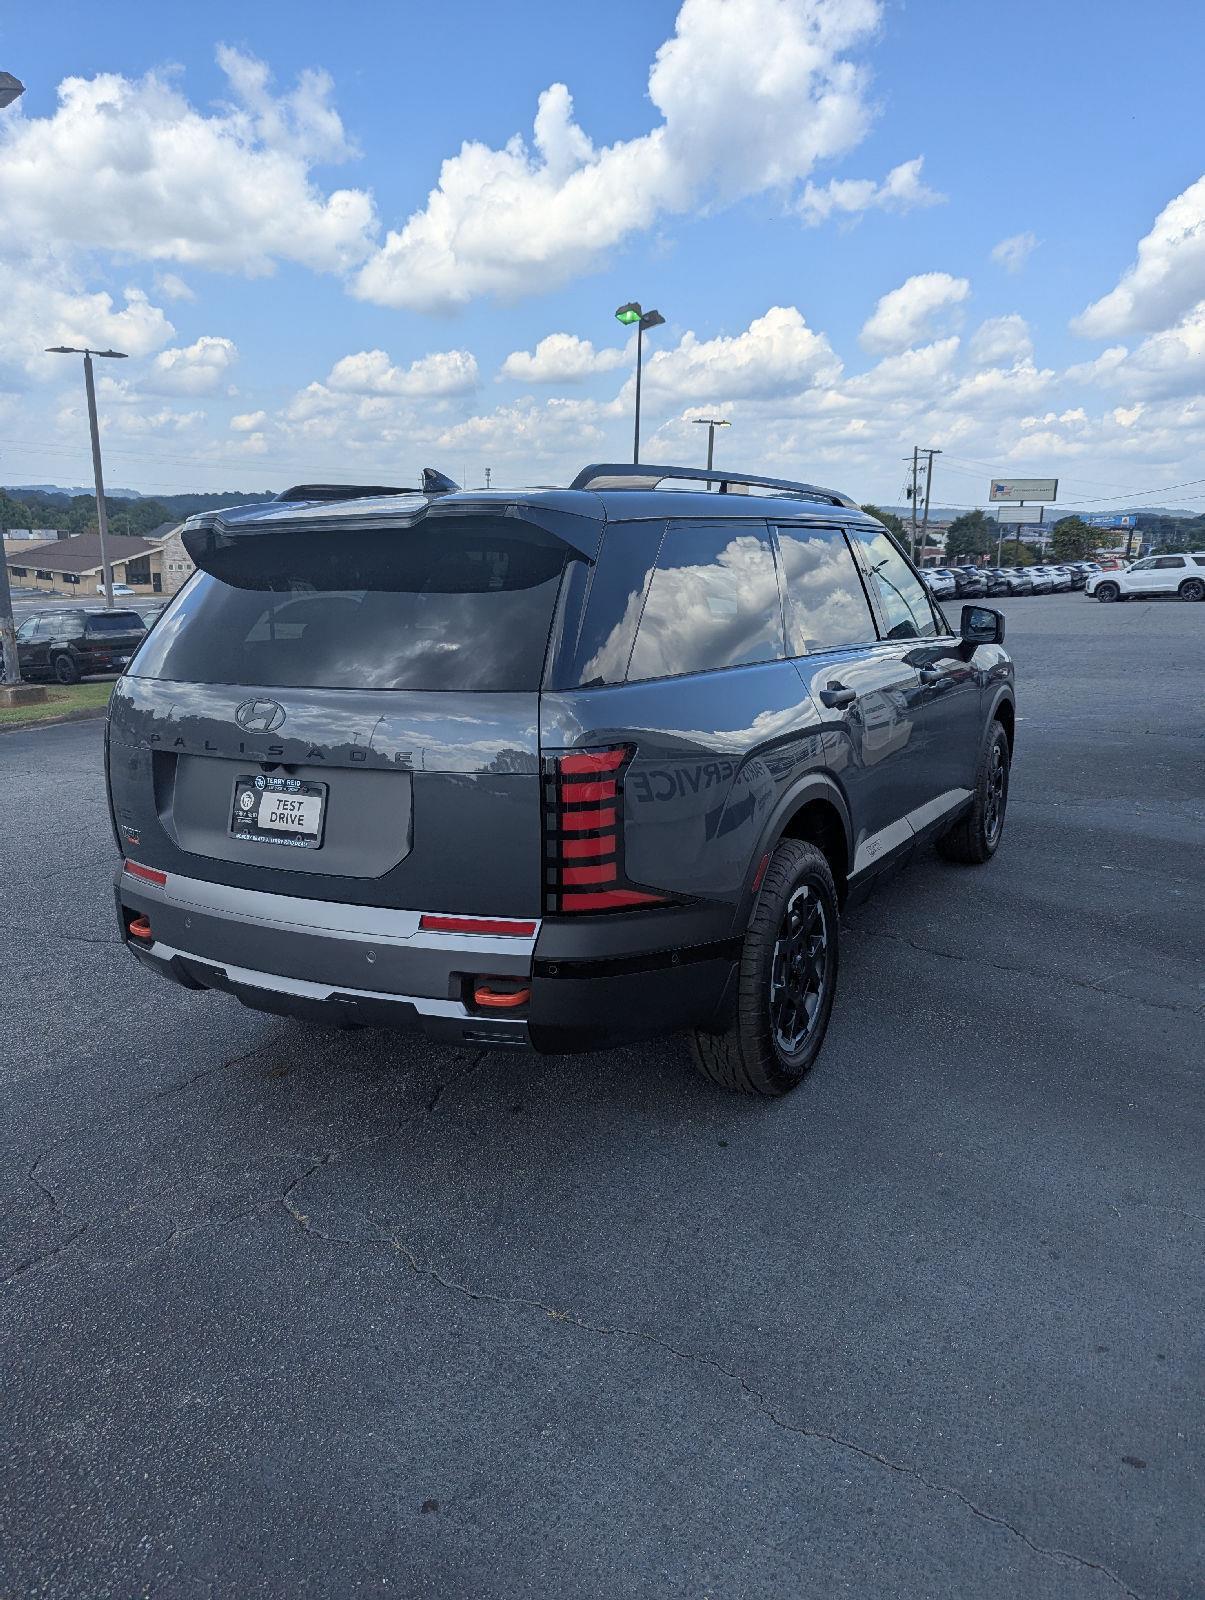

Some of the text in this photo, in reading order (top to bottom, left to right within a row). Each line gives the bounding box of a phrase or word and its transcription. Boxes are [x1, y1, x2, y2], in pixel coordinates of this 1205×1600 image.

[150, 733, 413, 763] PALISADE
[266, 777, 285, 785] TERRY
[276, 798, 304, 812] TEST
[269, 812, 304, 826] DRIVE
